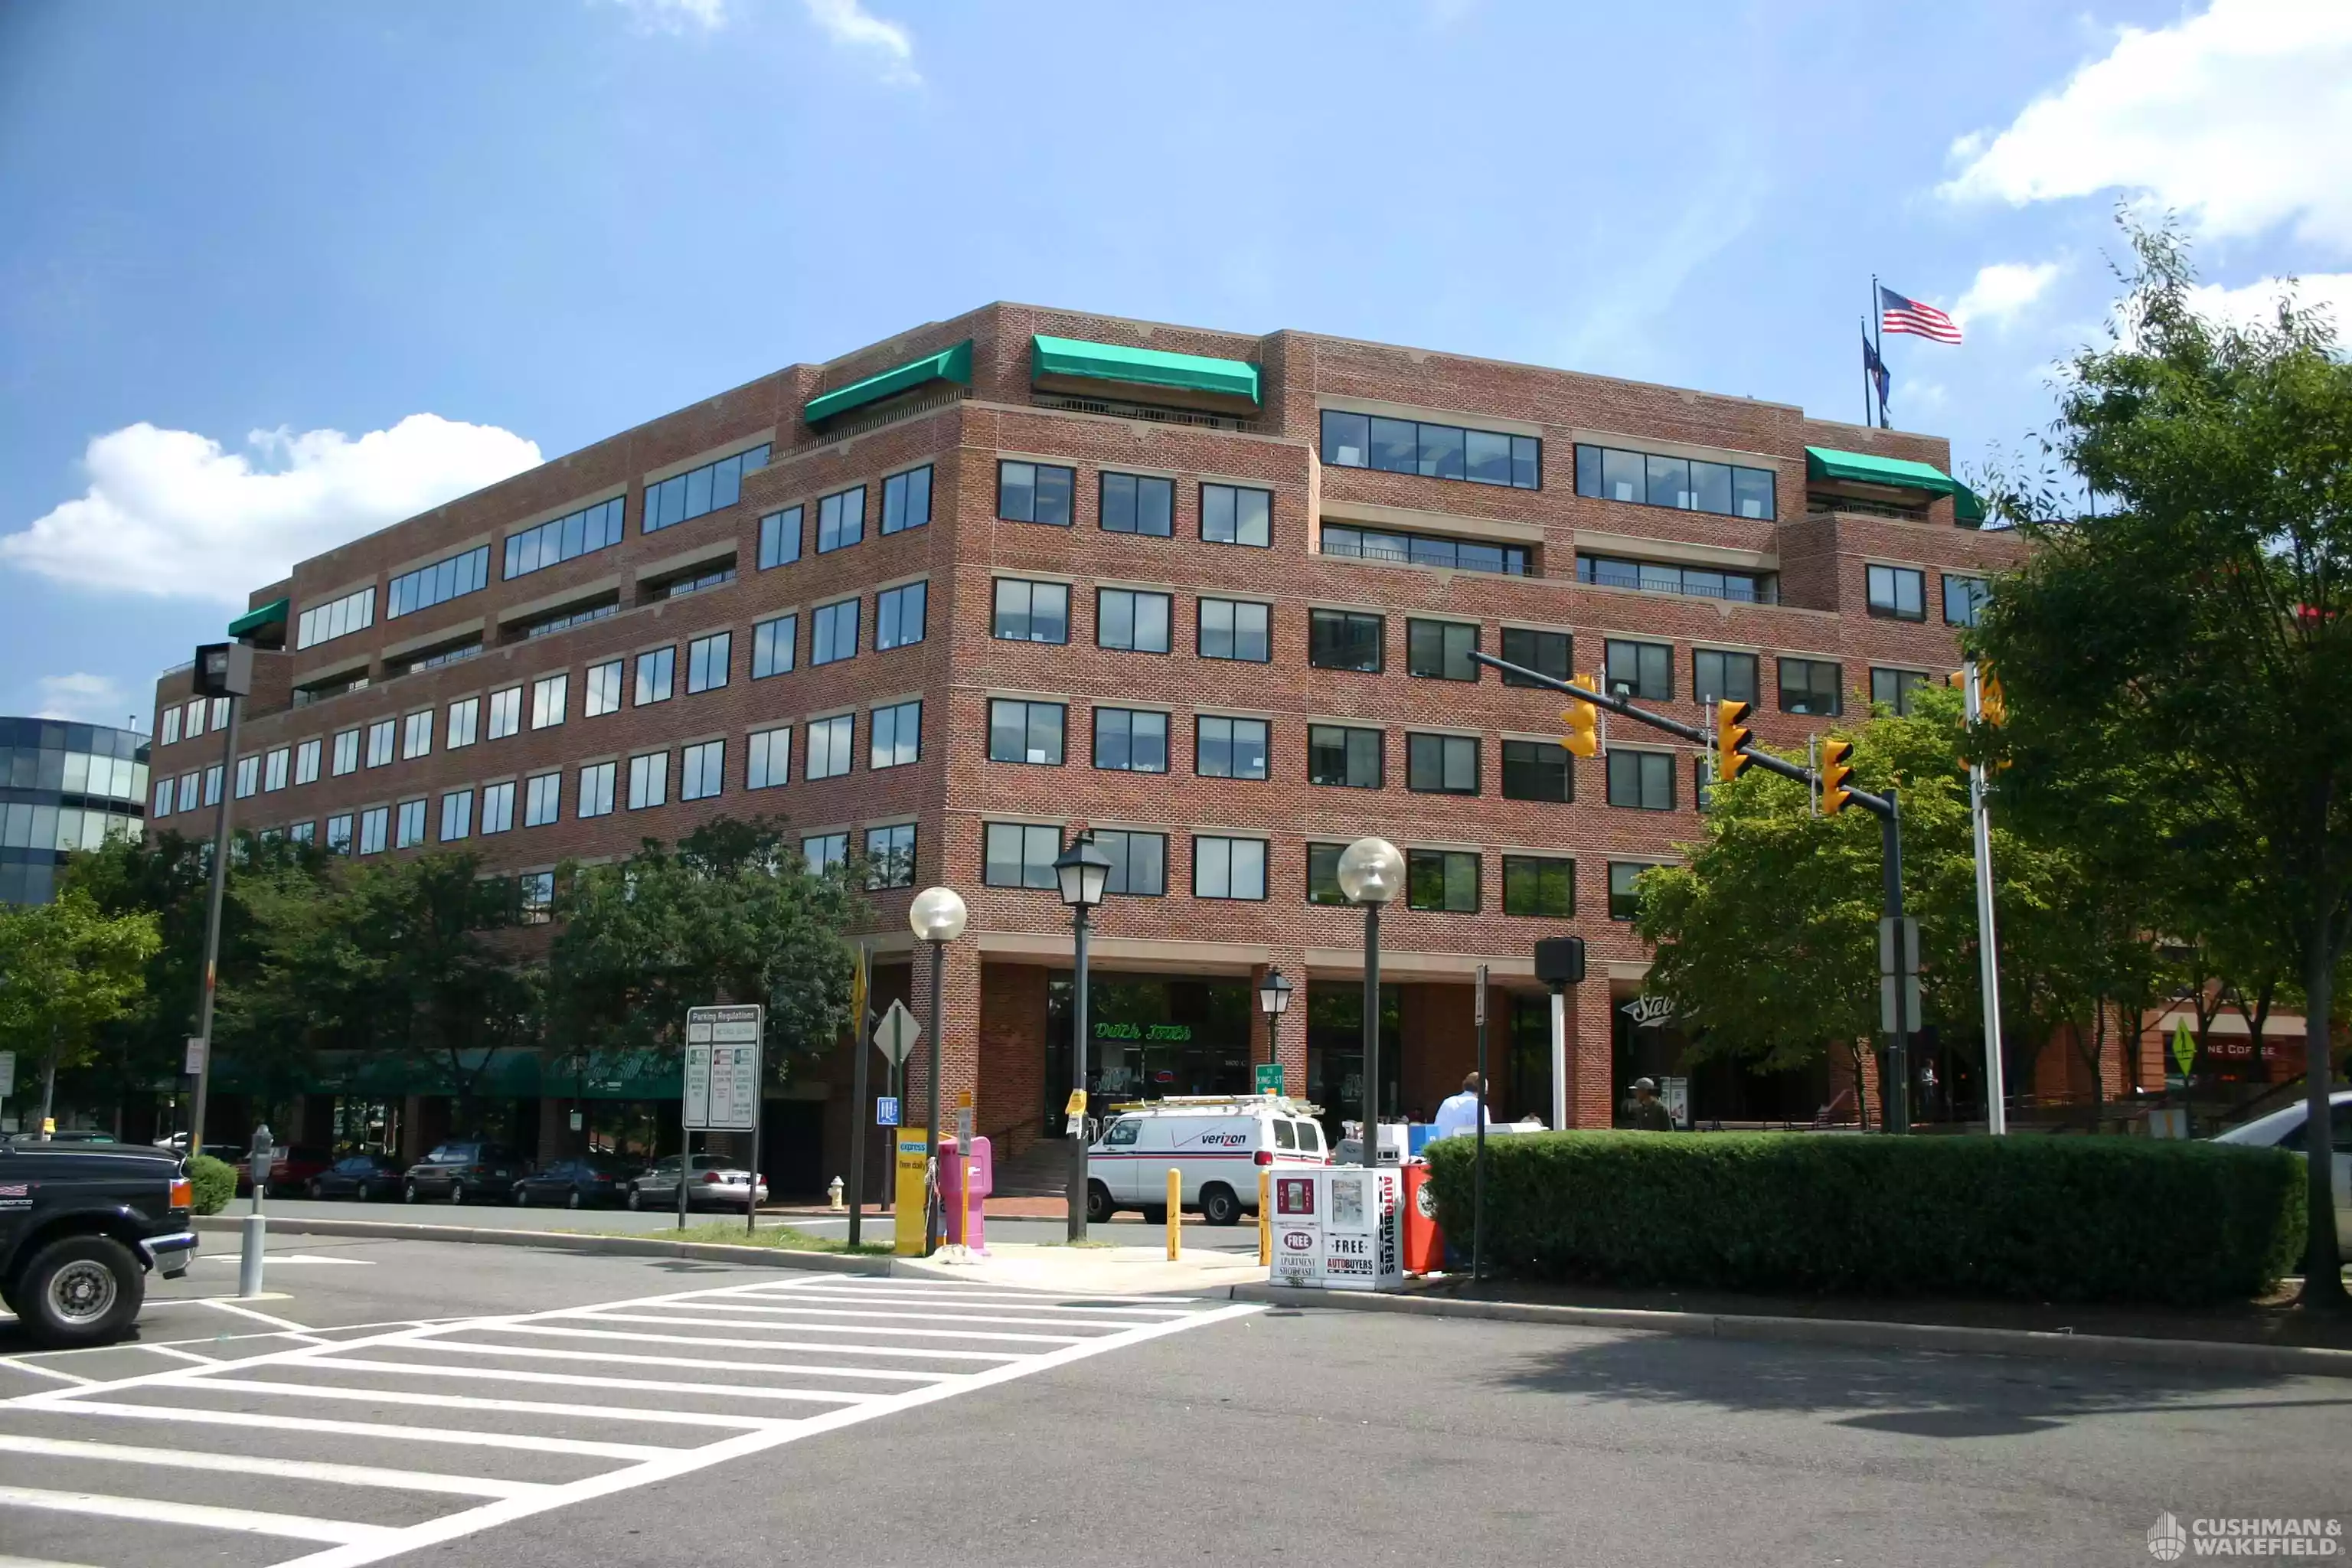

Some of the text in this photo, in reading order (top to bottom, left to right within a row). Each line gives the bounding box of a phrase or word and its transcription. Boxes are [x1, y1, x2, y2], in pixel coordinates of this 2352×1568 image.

[692, 1011, 754, 1022] Parking Regulations
[1094, 1023, 1141, 1039] Dutch
[2227, 1044, 2275, 1055] COFEE
[1202, 1132, 1246, 1146] verizon
[900, 1142, 926, 1152] express
[1383, 1176, 1395, 1275] AUTOBUYERS
[1287, 1233, 1309, 1247] FREE
[1335, 1240, 1364, 1253] FREE
[1328, 1258, 1373, 1270] AUTOBUYERS
